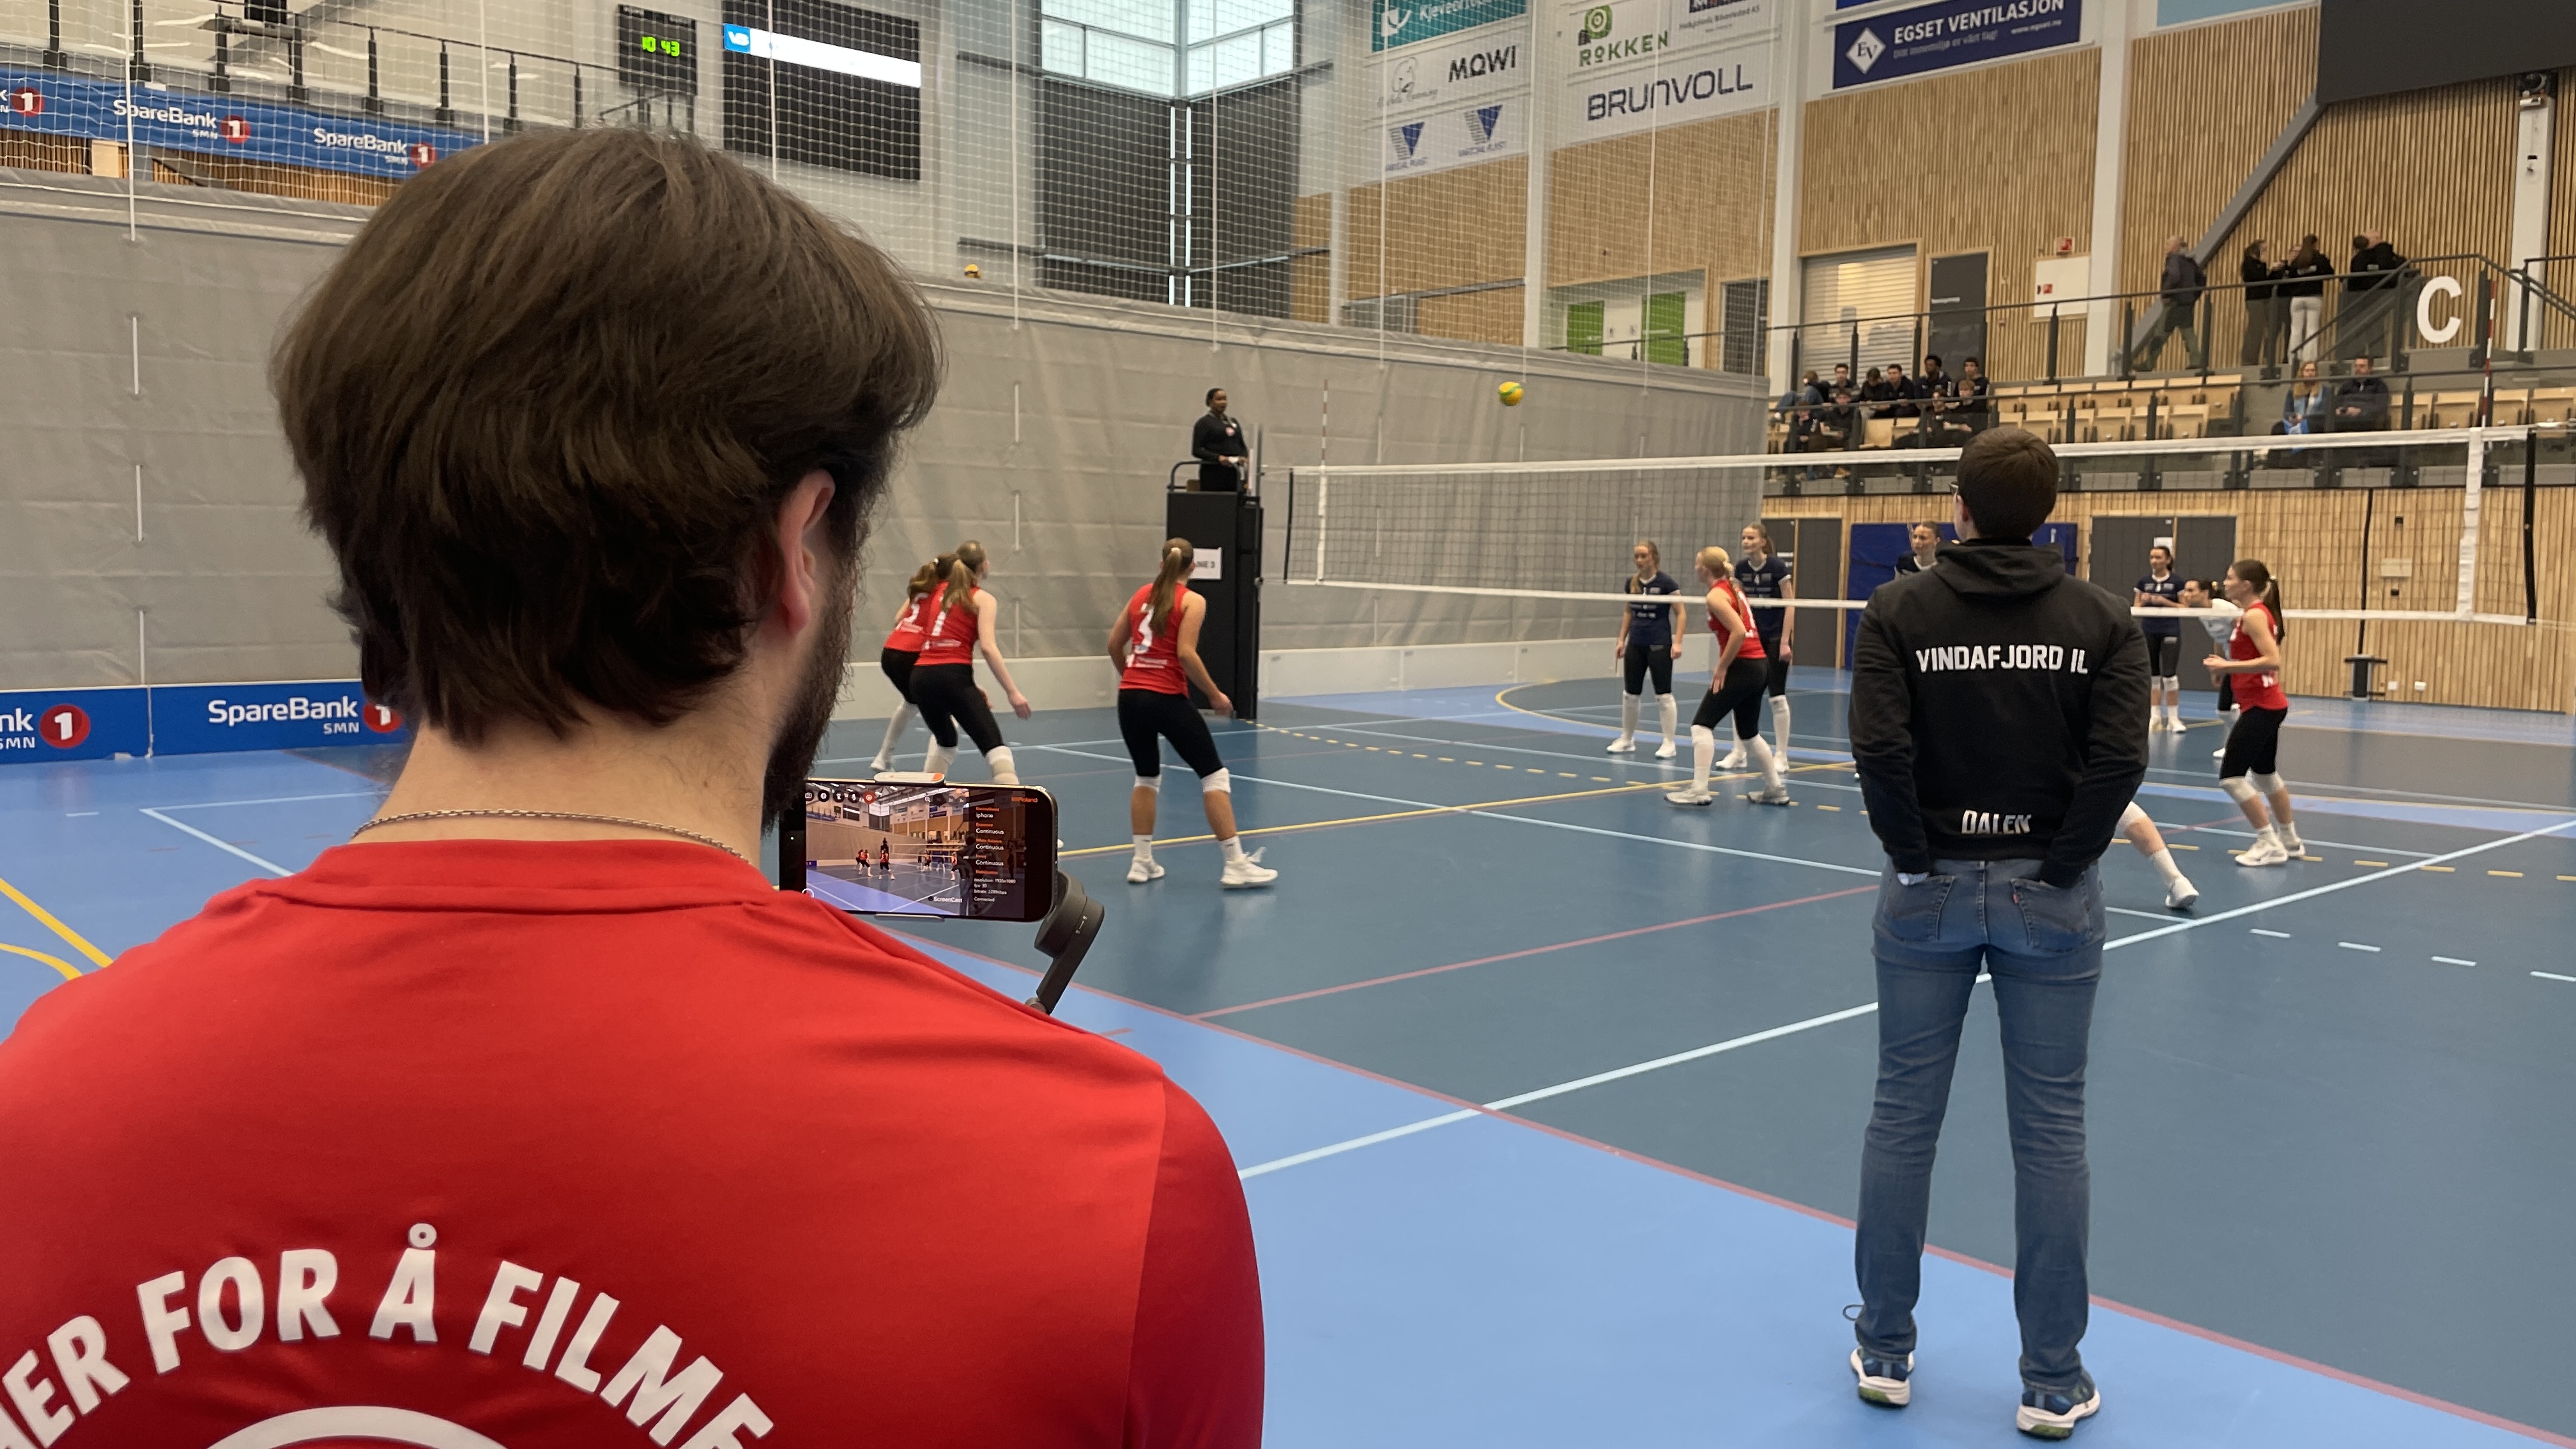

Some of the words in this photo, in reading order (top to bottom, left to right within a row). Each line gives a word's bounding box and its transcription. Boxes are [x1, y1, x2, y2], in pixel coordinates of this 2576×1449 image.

[1894, 18, 1944, 45] EGSET
[1948, 0, 2064, 32] VENTILASJON
[1588, 65, 1753, 121] BRUNVOLL
[113, 100, 217, 128] SpareBank
[314, 128, 407, 155] SpareBank
[2417, 276, 2462, 343] C
[1916, 645, 2064, 673] VINDAFJORD
[2070, 648, 2089, 674] IL
[208, 695, 358, 726] SpareBank
[54, 712, 73, 740] 1
[323, 722, 359, 735] SMN
[1961, 809, 2032, 834] DALEN
[136, 1249, 341, 1376] FOR
[369, 1223, 438, 1342] Å
